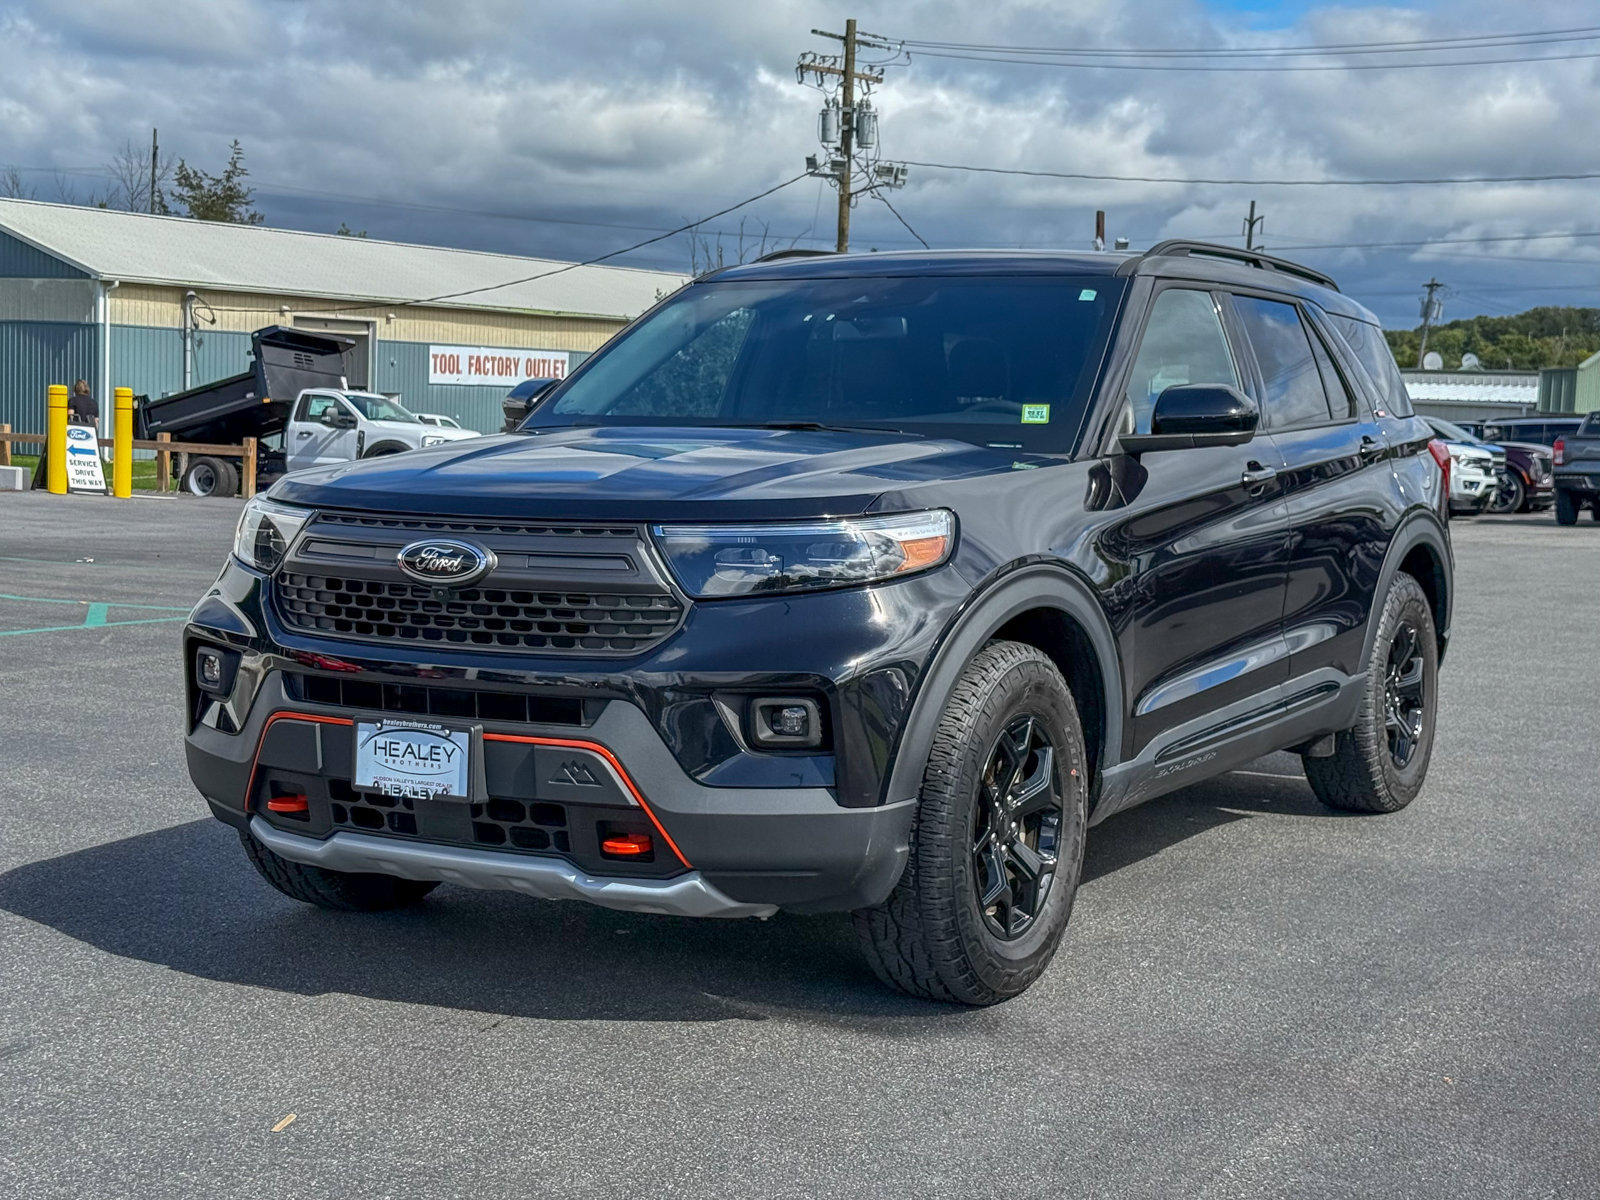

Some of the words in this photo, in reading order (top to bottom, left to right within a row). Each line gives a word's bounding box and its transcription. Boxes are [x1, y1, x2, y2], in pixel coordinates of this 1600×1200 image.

[431, 353, 462, 375] TOOL
[468, 355, 520, 377] FACTORY
[525, 357, 567, 379] OUTLET
[69, 459, 98, 468] SERVICE
[75, 469, 96, 477] DRIVE
[71, 478, 87, 486] THIS
[88, 479, 103, 487] WAY
[415, 546, 464, 572] Ford
[382, 719, 442, 729] healeybrothers.com
[373, 739, 457, 763] HEALEY
[385, 759, 441, 769] BROTHERS
[414, 779, 435, 787] LARGEST
[381, 784, 437, 800] HEALEY
